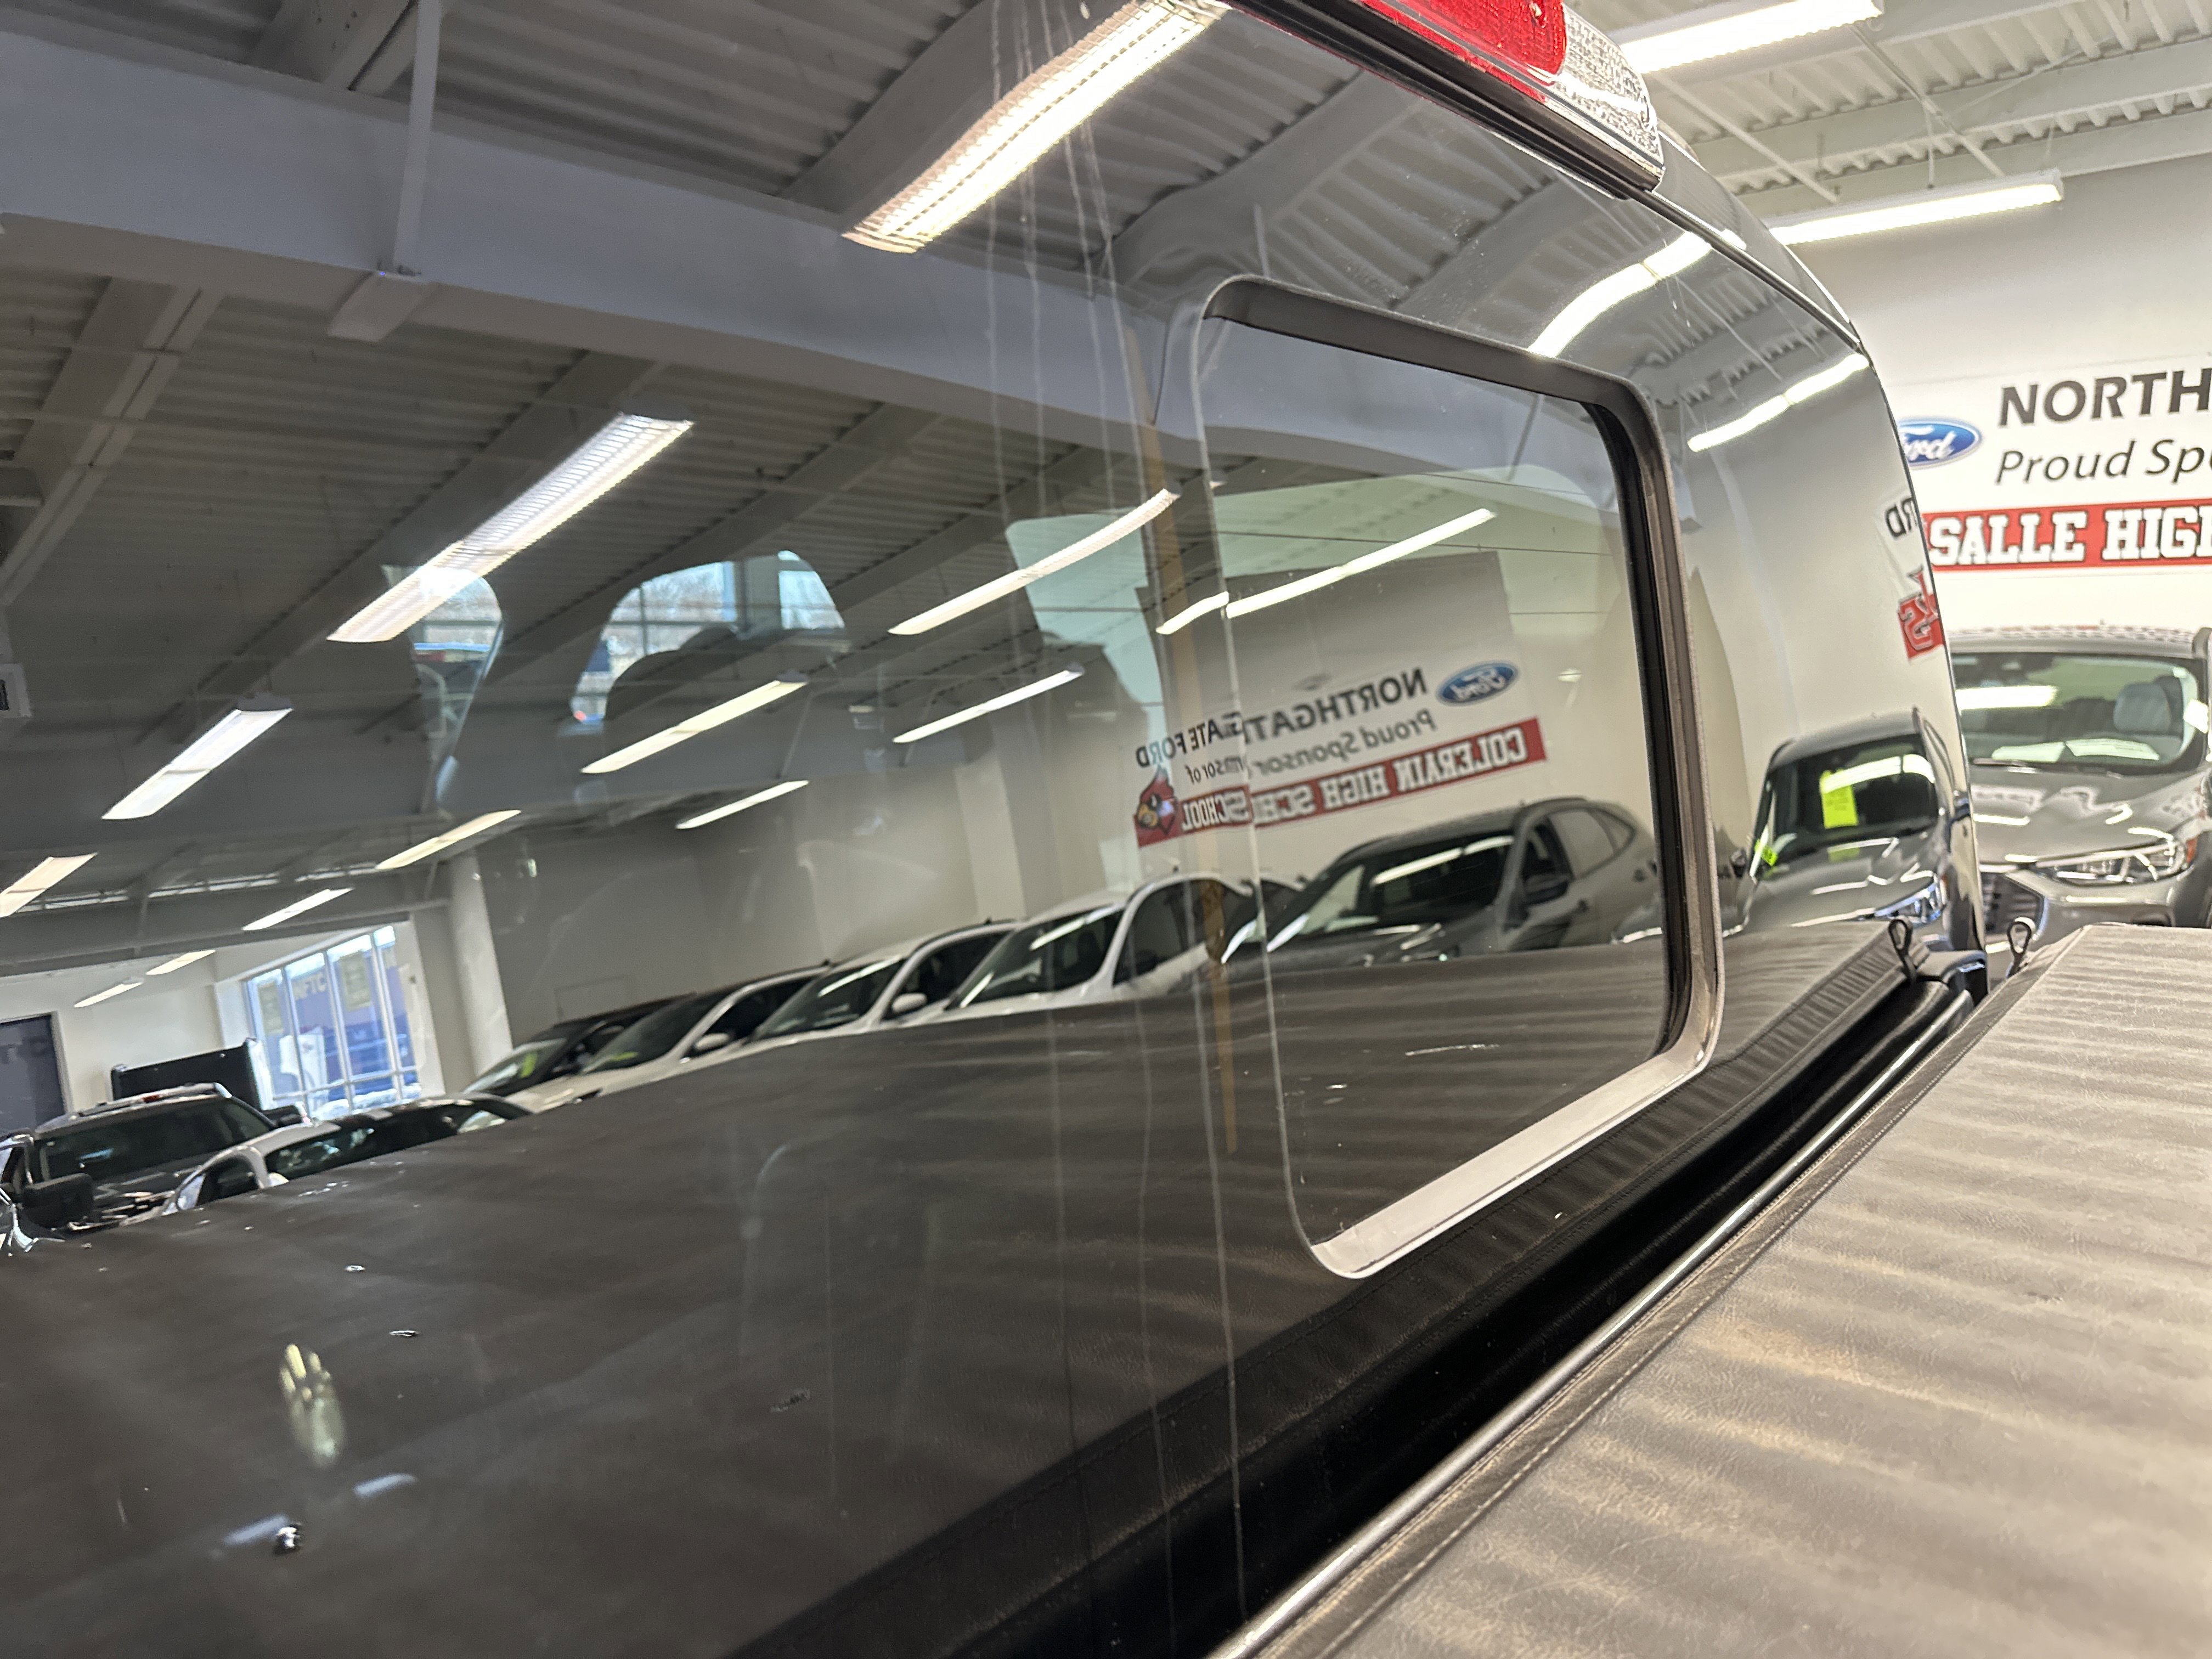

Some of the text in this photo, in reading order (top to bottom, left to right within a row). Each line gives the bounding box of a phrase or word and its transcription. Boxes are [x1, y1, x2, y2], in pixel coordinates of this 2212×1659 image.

[1999, 367, 2212, 427] NORTH
[1995, 439, 2212, 485] Proud Sp
[1929, 510, 2087, 566] SALLE
